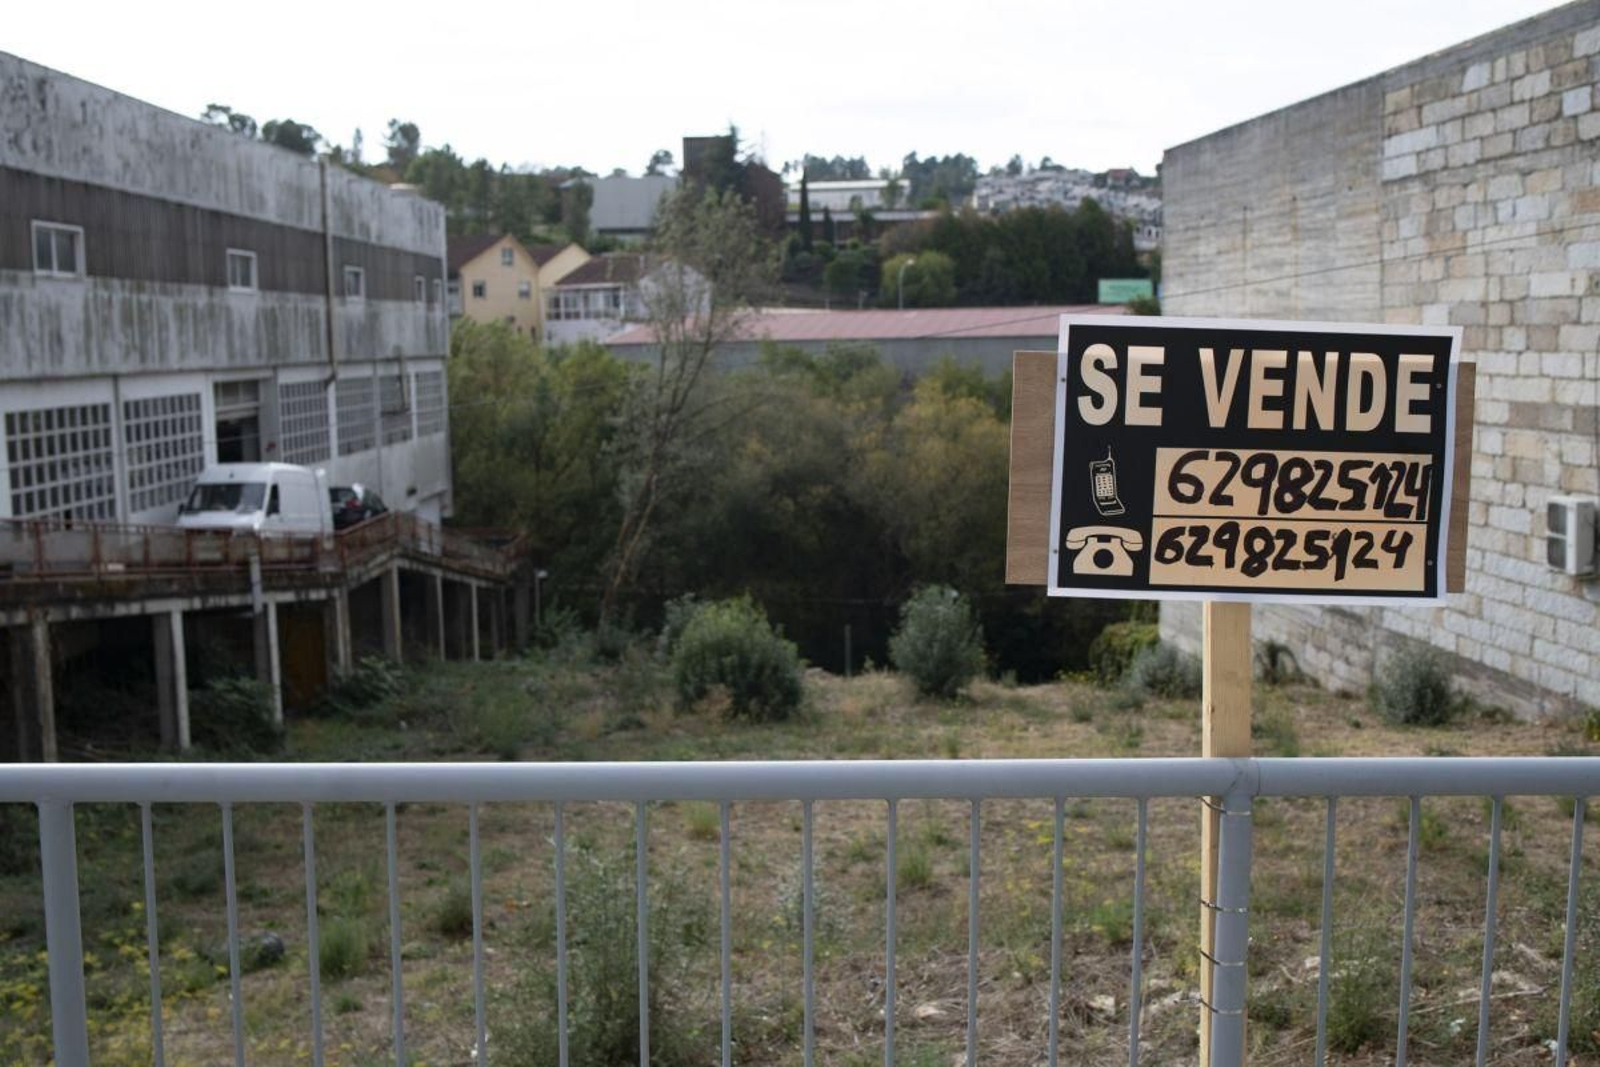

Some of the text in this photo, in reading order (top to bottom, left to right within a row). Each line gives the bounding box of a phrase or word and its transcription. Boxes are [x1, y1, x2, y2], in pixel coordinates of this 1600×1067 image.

[1077, 343, 1435, 433] SE VENDE
[1167, 450, 1432, 521] 629825124
[1154, 521, 1413, 581] 629825124
